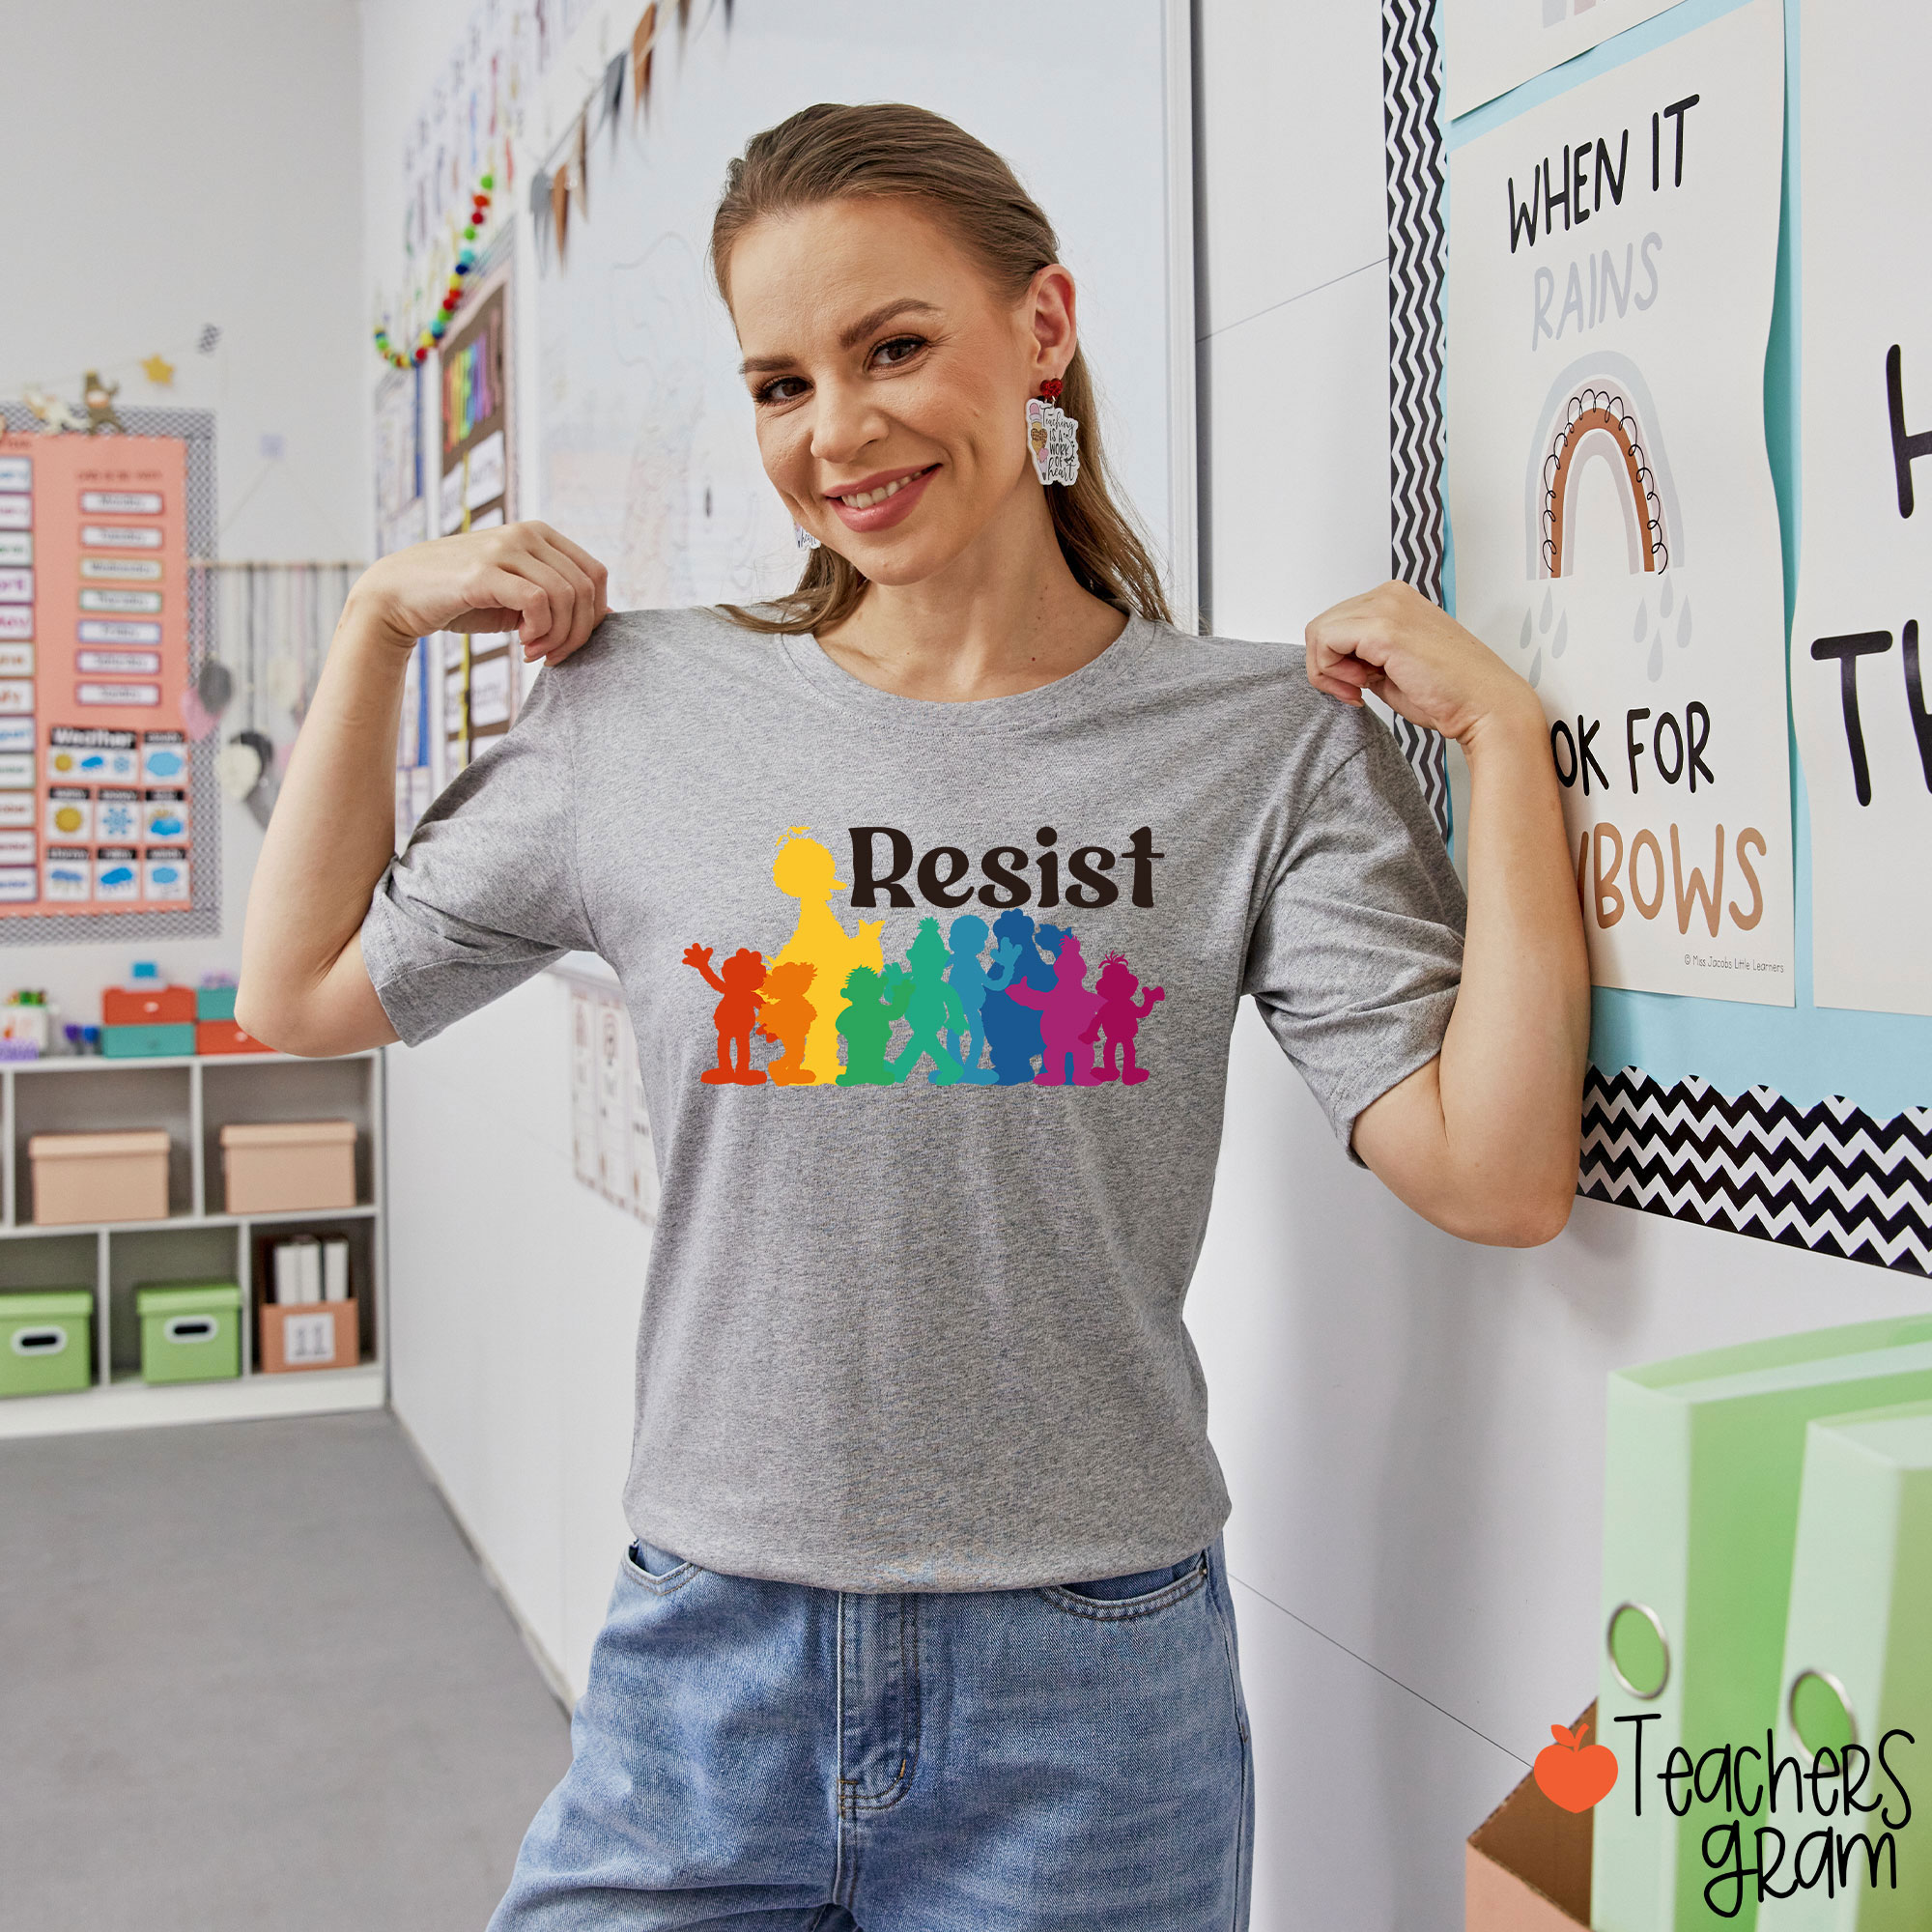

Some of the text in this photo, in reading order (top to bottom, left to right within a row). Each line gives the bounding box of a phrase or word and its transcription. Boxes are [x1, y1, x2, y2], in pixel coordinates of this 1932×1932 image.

[1507, 93, 1700, 254] WHEN IT
[1531, 231, 1662, 352] RAINS
[1047, 457, 1077, 482] heart
[1049, 442, 1068, 457] WORK
[1055, 456, 1063, 468] OF
[1550, 700, 1715, 797] OK FOR
[848, 826, 1165, 908] Resist
[1577, 821, 1767, 938] BOWS
[1692, 954, 1706, 967] Miss
[1708, 955, 1732, 970] Jacobs
[1734, 957, 1750, 971] Little
[1752, 959, 1784, 974] Learners
